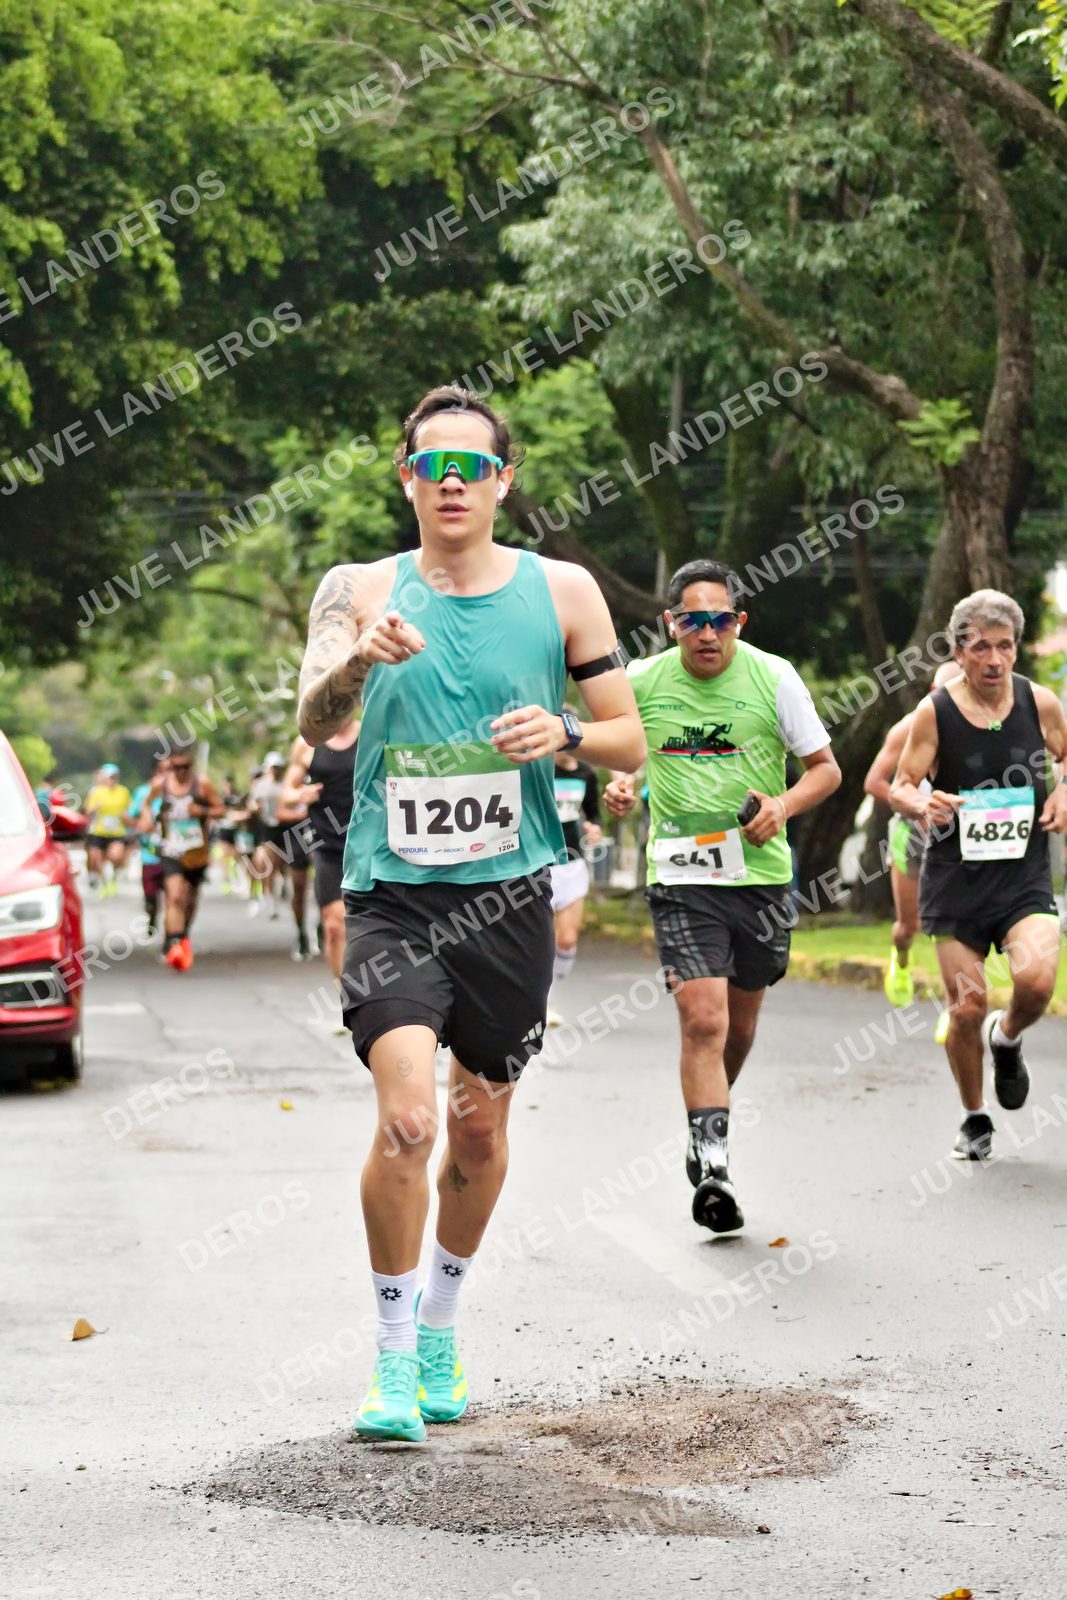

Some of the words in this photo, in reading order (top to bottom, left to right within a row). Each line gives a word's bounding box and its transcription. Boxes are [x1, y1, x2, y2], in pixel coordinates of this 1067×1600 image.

[683, 726, 705, 737] TEAM
[399, 794, 513, 835] 1204
[966, 820, 1029, 842] 4826
[498, 842, 515, 853] 1204
[669, 847, 724, 869] 641
